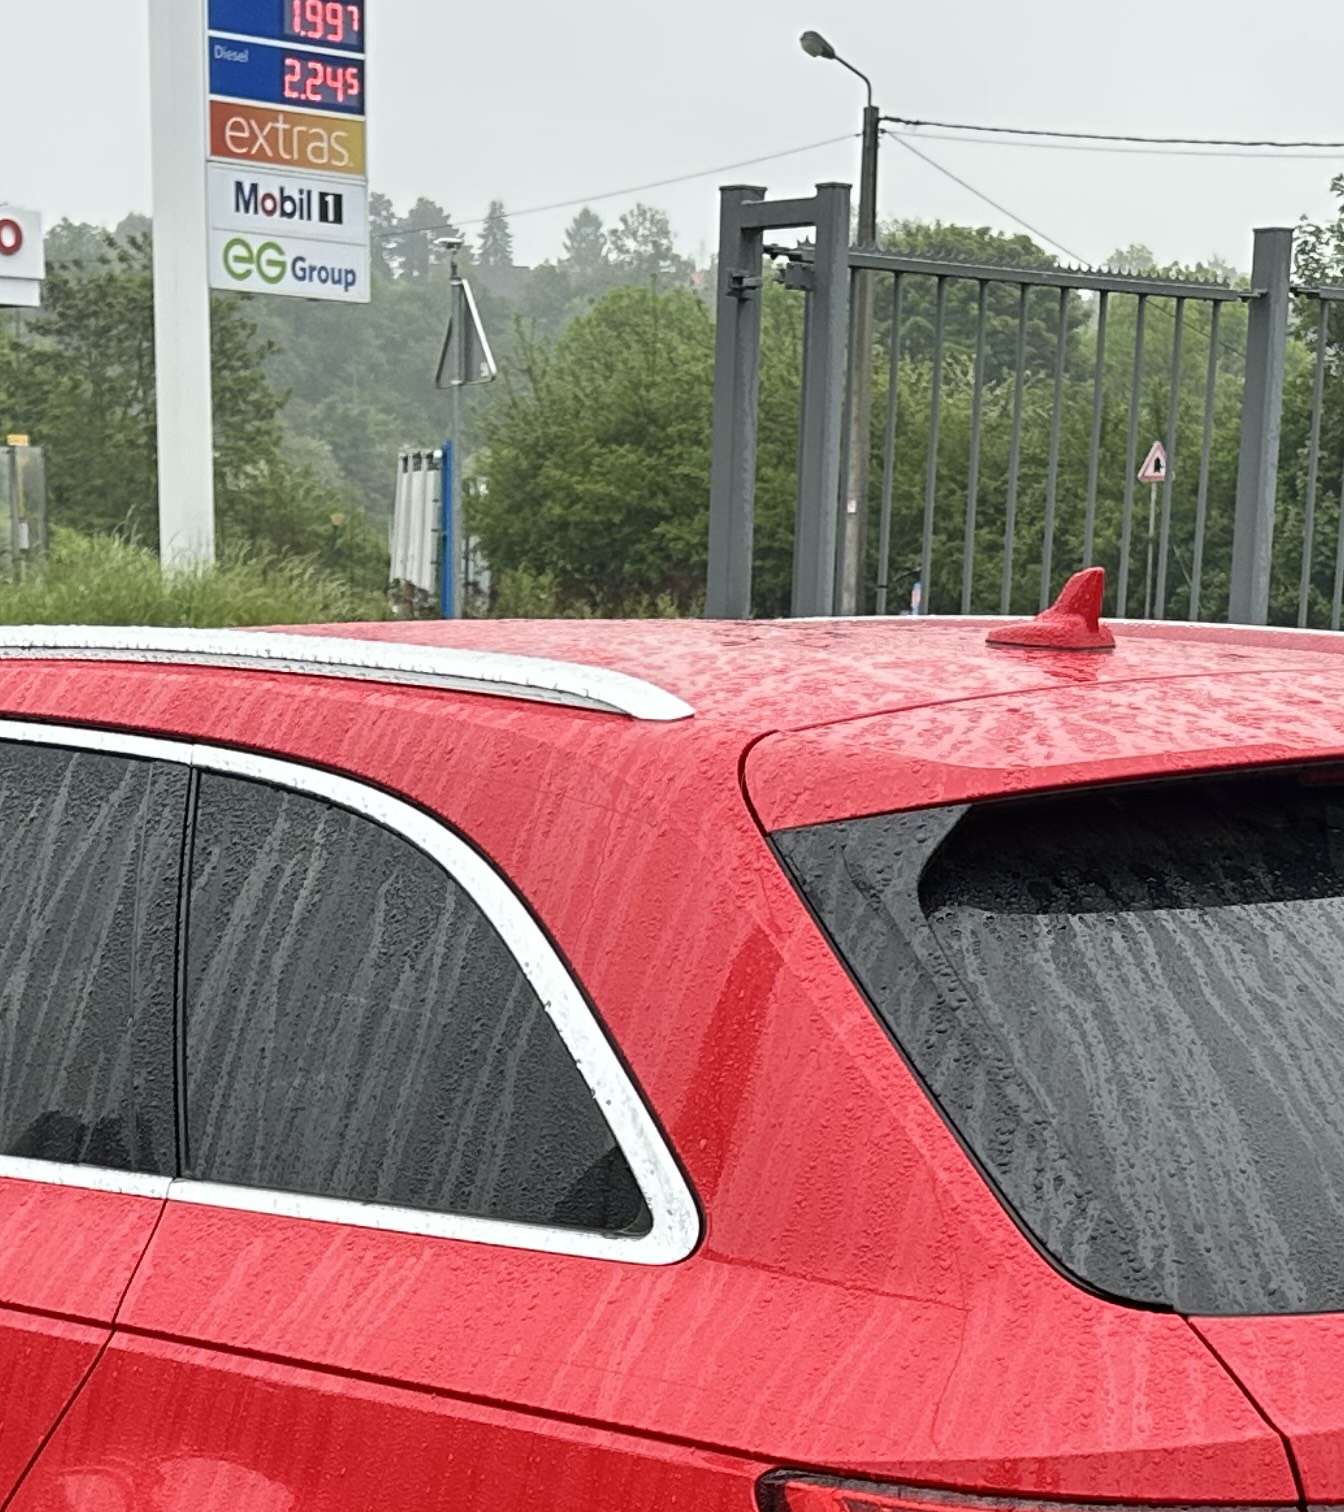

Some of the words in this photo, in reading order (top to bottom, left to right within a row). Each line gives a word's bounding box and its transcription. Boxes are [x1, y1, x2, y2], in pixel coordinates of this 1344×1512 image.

[214, 45, 249, 62] Diesel
[283, 58, 360, 102] 2.245
[225, 113, 350, 166] extras
[235, 180, 312, 221] Mobil
[318, 191, 343, 225] 1
[291, 256, 356, 292] Group
